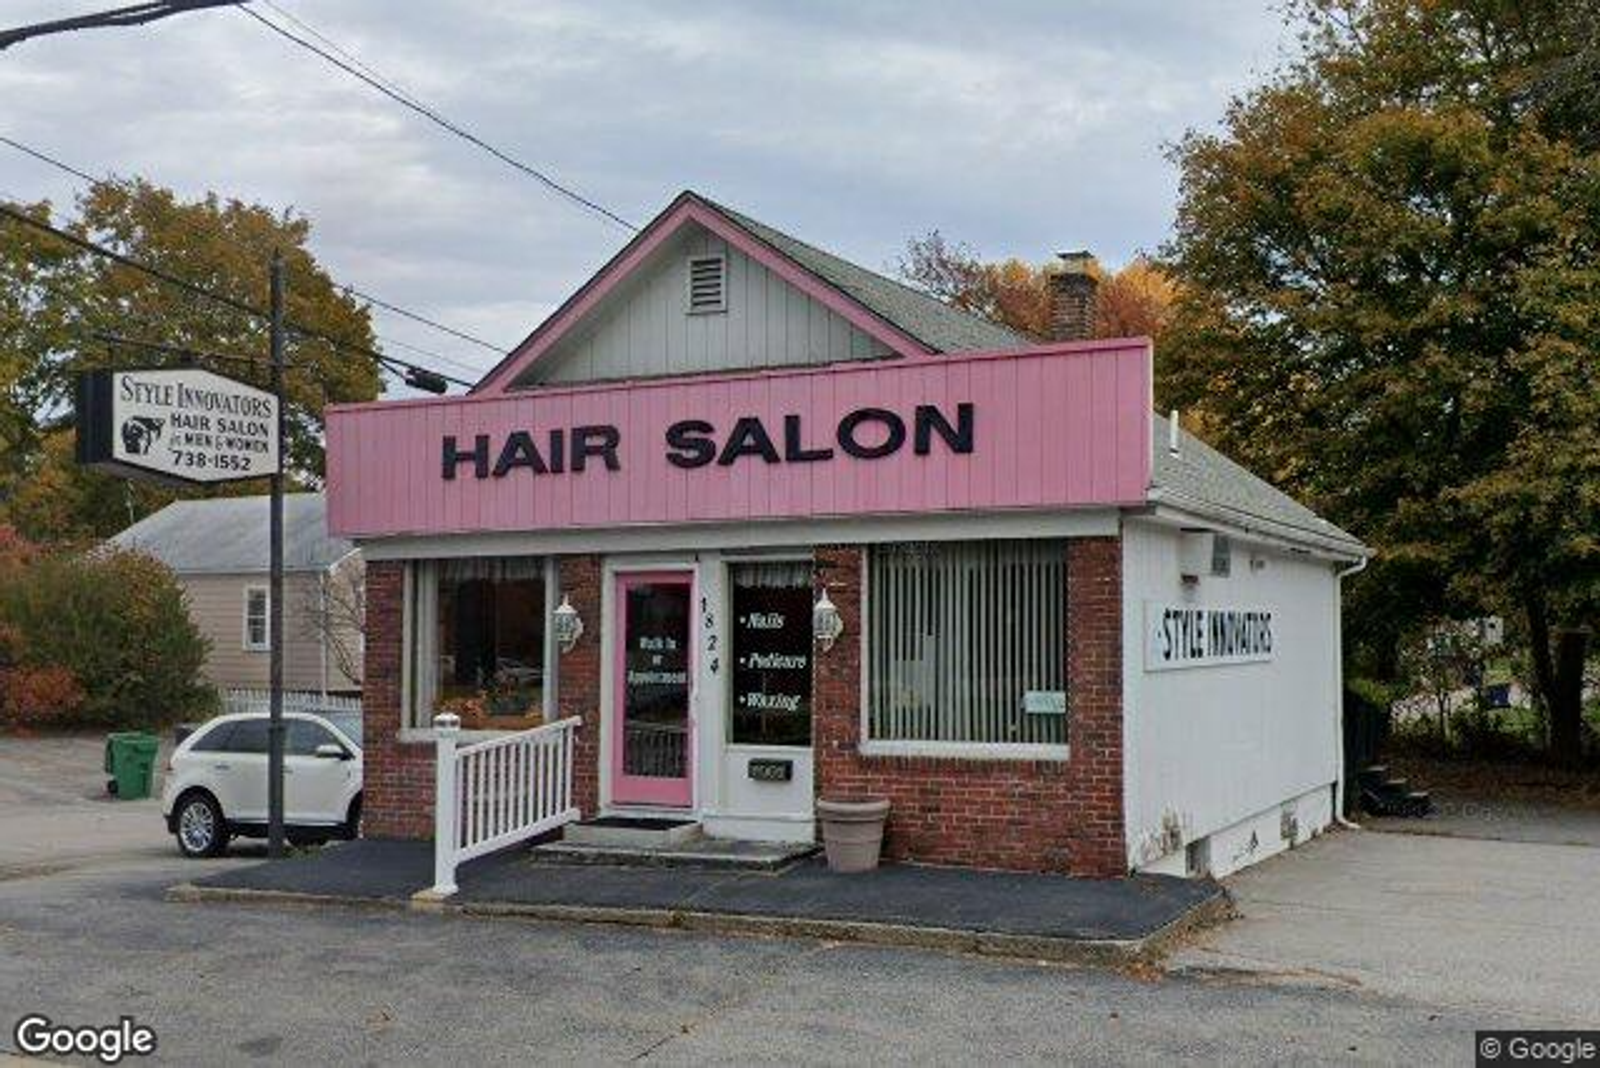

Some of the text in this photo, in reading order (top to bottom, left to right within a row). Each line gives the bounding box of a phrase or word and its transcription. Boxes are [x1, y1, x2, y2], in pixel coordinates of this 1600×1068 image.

[121, 375, 272, 418] STYLE INNOVATORS
[171, 413, 269, 438] HAIR SALON
[185, 433, 212, 447] MEN
[215, 435, 222, 451] &
[223, 437, 269, 453] WOMEN
[442, 402, 975, 480] HAIR SALON
[173, 450, 251, 471] 738-1552
[746, 612, 785, 630] Nails
[1163, 608, 1272, 661] STYLE INNOVATORS
[746, 692, 801, 711] Waxing
